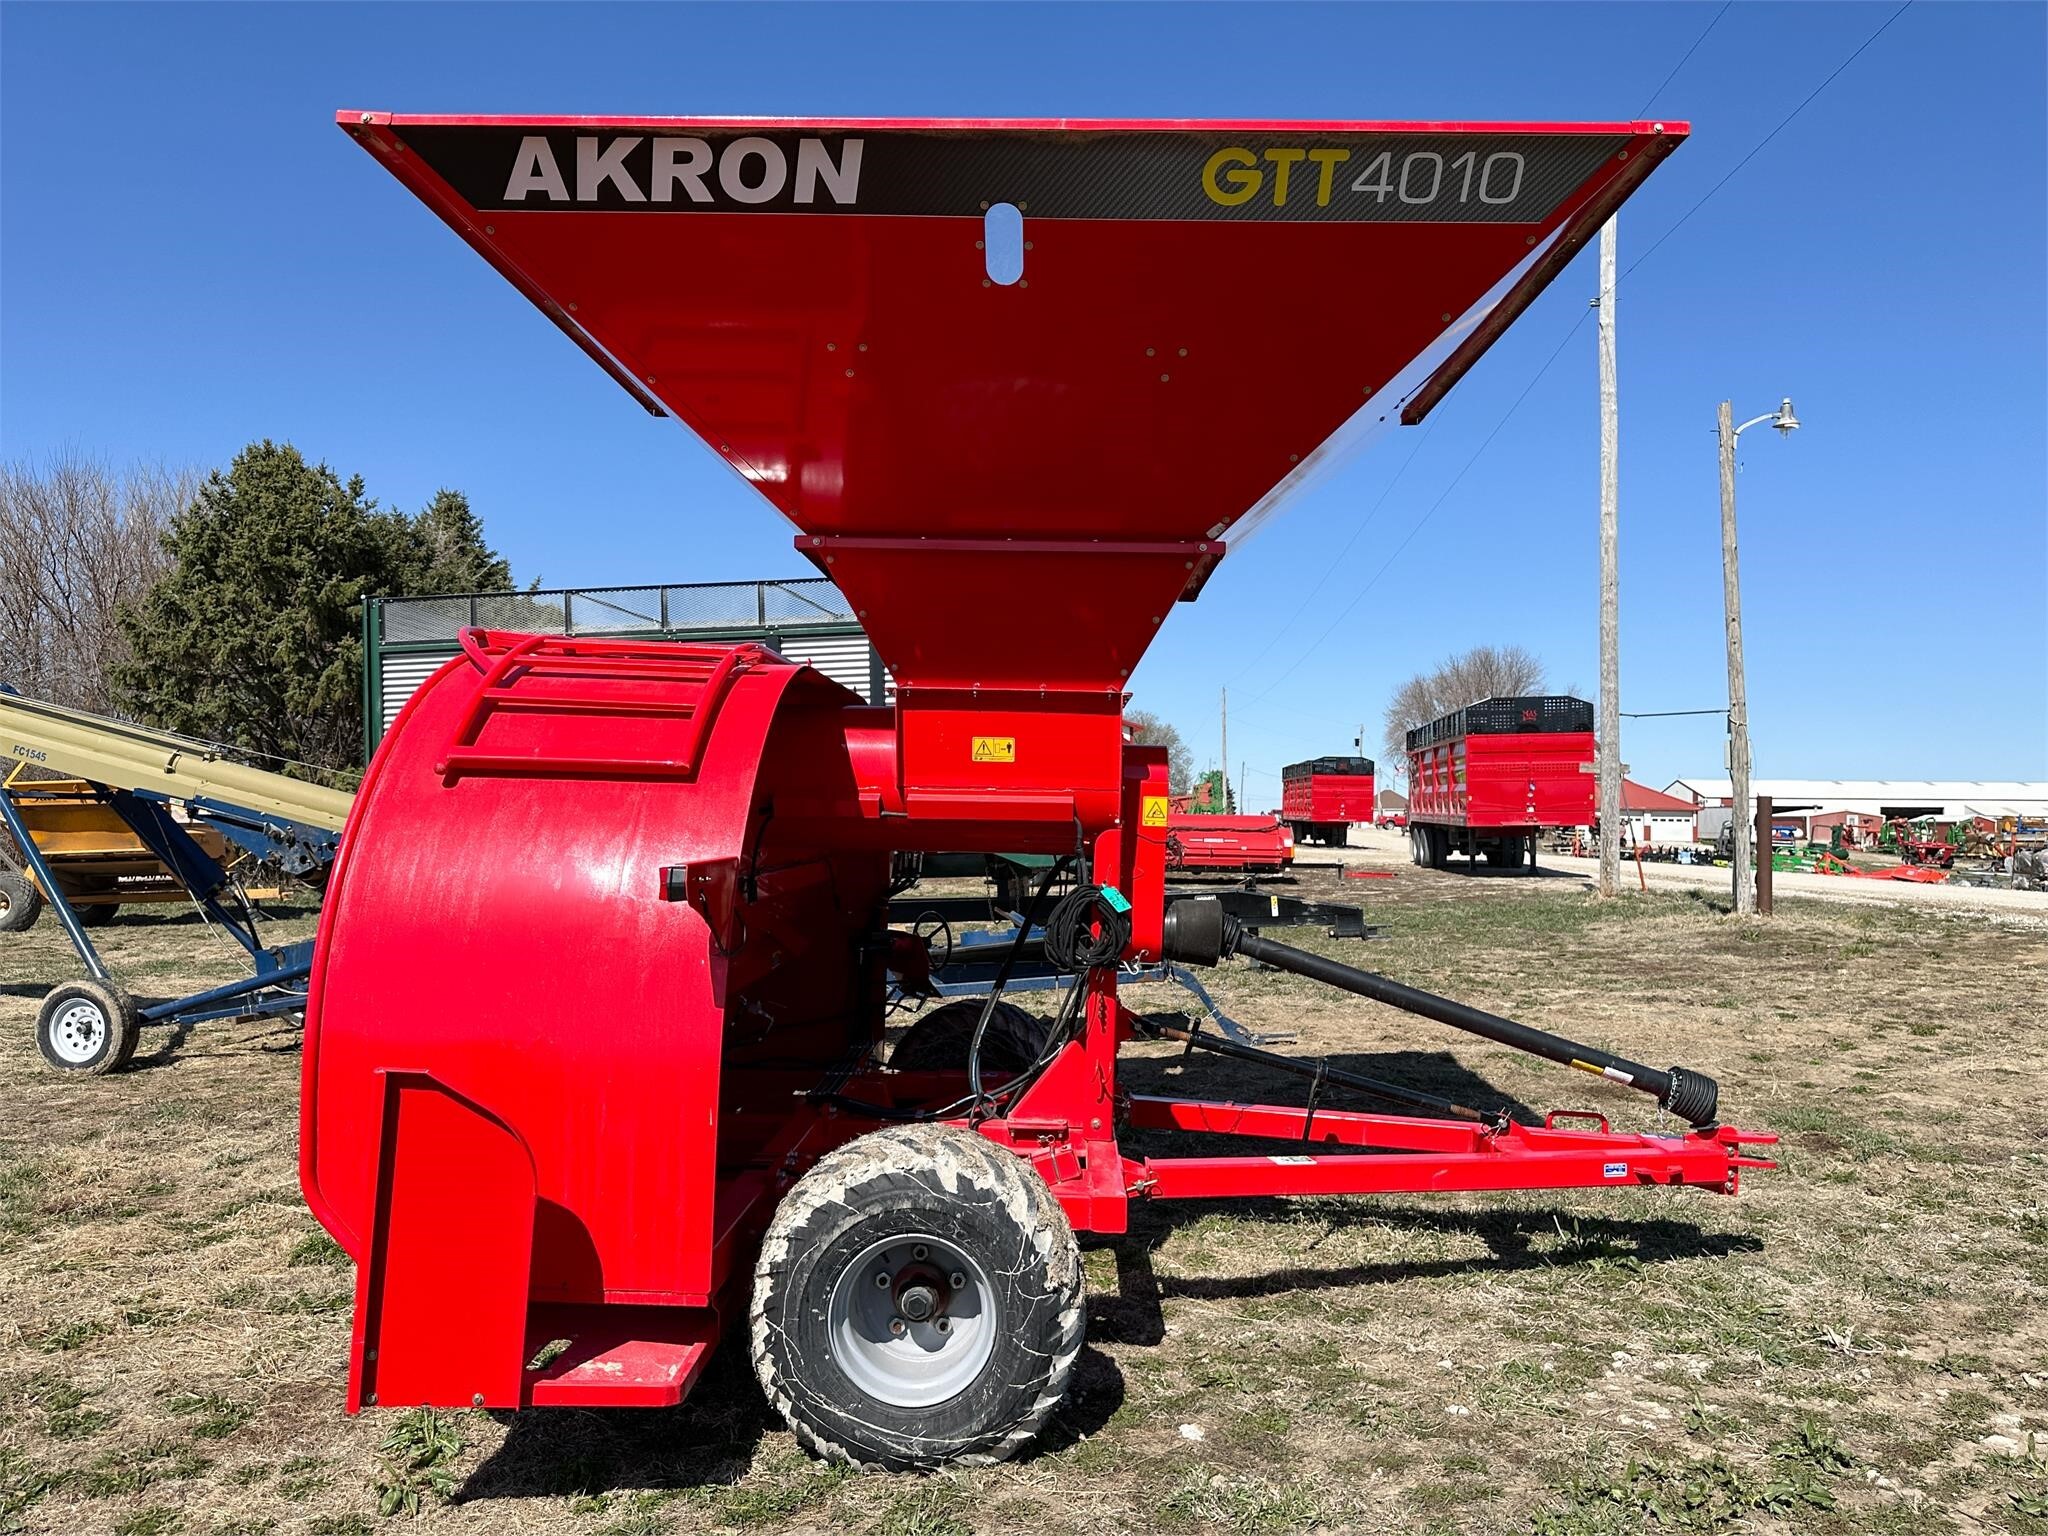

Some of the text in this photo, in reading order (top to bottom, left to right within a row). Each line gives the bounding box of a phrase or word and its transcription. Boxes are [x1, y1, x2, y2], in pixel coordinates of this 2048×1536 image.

[503, 136, 865, 204] AKRON
[1202, 147, 1525, 207] GTT 4010
[13, 745, 47, 761] FC1545
